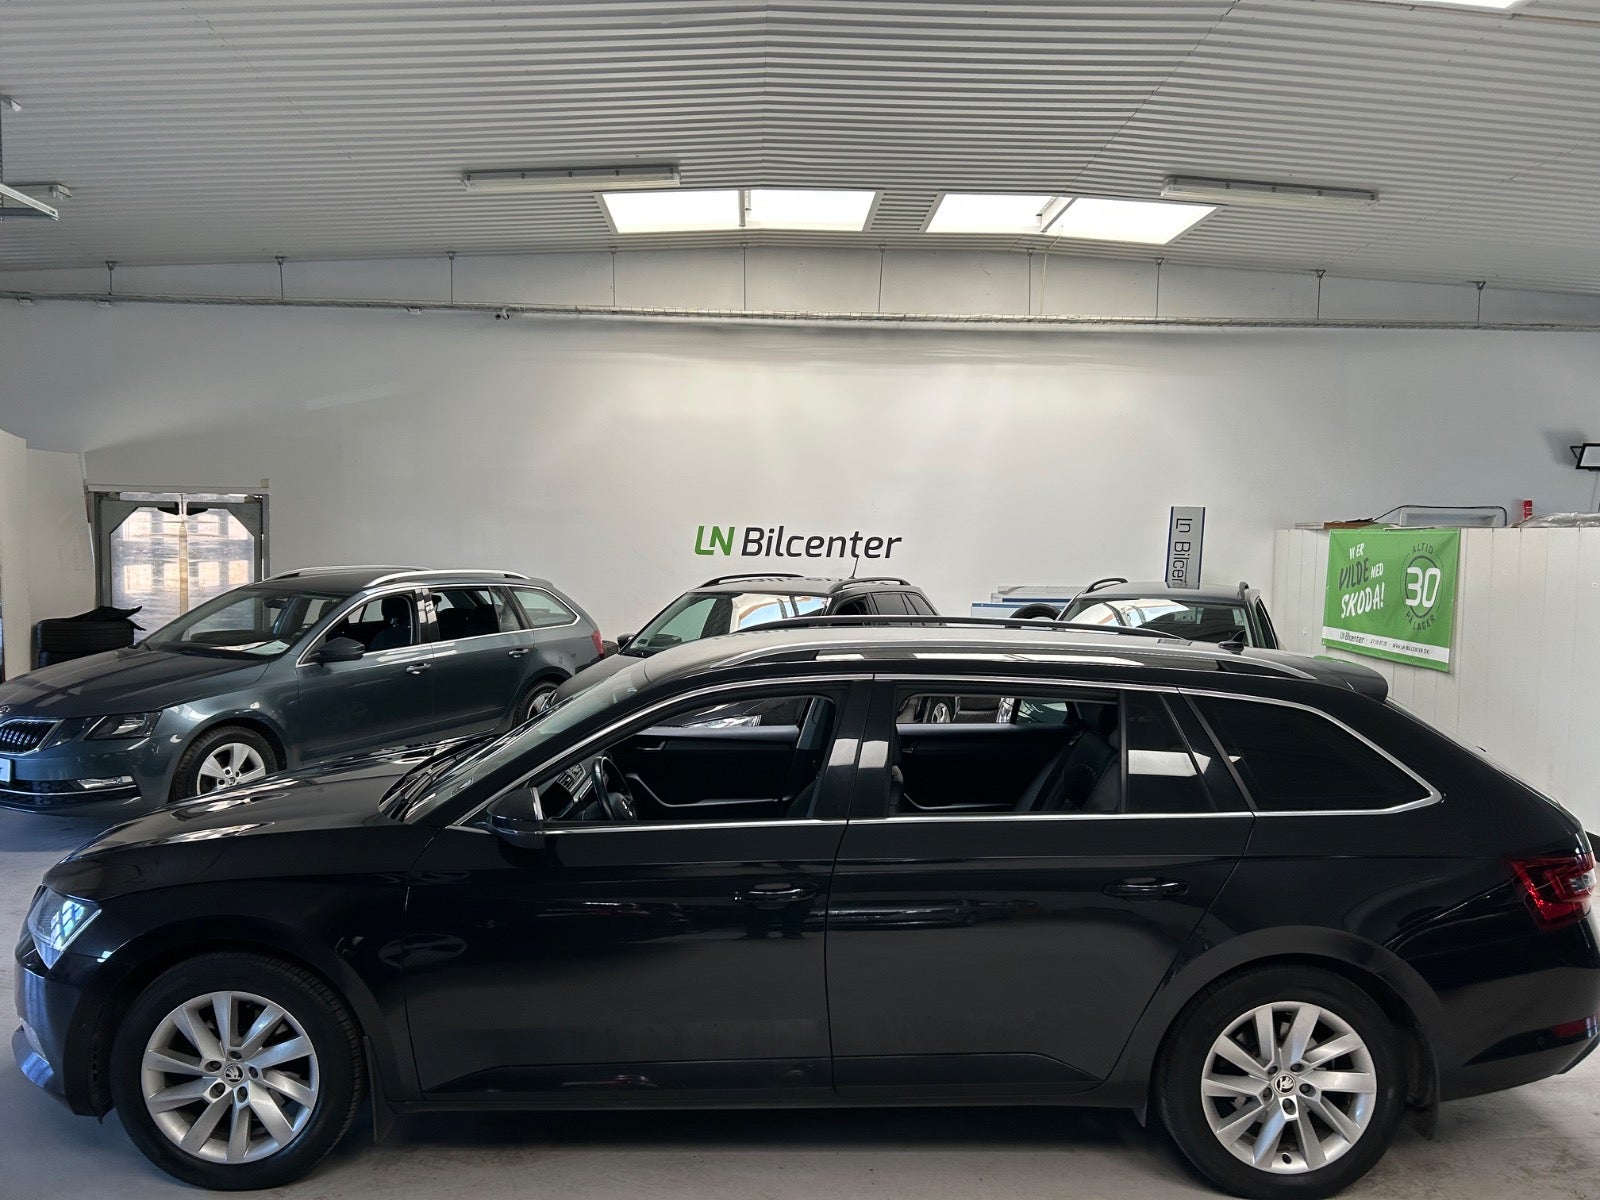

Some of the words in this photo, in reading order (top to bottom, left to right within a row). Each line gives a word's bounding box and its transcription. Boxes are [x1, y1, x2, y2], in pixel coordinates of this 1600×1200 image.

[1175, 518, 1193, 533] Ln
[694, 526, 735, 556] LN
[741, 526, 902, 558] Bilcenter
[1356, 543, 1365, 557] ER
[1412, 543, 1433, 554] ALTID
[1339, 557, 1369, 591] VILDE
[1405, 566, 1441, 608] 30
[1341, 581, 1385, 619] SKODA!
[1413, 614, 1436, 632] LAGER
